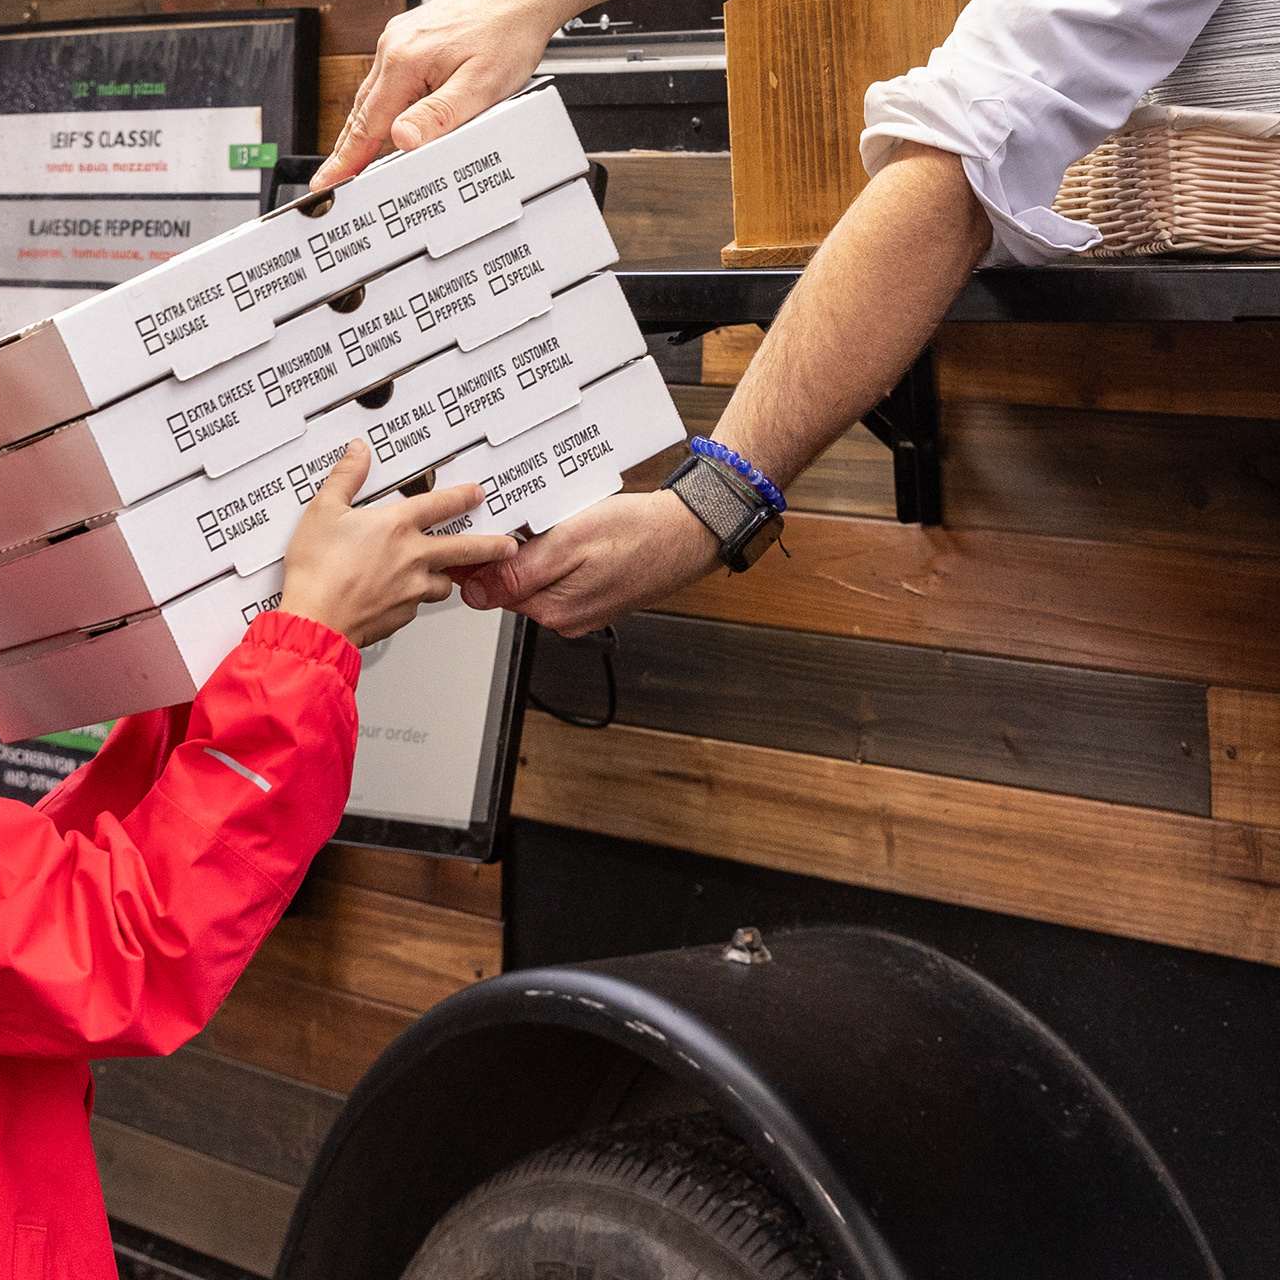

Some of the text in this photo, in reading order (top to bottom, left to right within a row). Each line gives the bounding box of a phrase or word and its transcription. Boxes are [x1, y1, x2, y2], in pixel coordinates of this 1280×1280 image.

[98, 129, 163, 148] CLASSIC
[453, 151, 502, 183] CUSTOMER
[477, 168, 515, 193] SPECIAL
[397, 177, 448, 211] ANCHOVIES
[28, 218, 192, 238] LAKESIDE PEPPERONI
[327, 211, 377, 245] MEAT BALL
[404, 200, 447, 229] PEPPERS
[246, 247, 302, 282] MUSHROOM
[335, 237, 372, 263] ONIONS
[483, 243, 532, 276] CUSTOMER
[254, 268, 308, 302] PEPPERONI
[427, 270, 478, 304] ANCHOVIES
[506, 260, 545, 287] SPECIAL
[156, 283, 225, 326] EXTRA CHEESE
[434, 293, 477, 322] PEPPERS
[163, 315, 210, 345] SAUSAGE
[357, 305, 408, 339] MEAT BALL
[276, 342, 333, 378] MUSHROOM
[365, 330, 402, 357] ONIONS
[511, 336, 560, 370] CUSTOMER
[285, 362, 338, 398] PEPPERONI
[455, 364, 507, 399] ANCHOVIES
[535, 353, 573, 380] SPECIAL
[186, 380, 256, 423] EXTRA CHEESE
[463, 387, 505, 417] PEPPERS
[194, 410, 240, 442] SAUSAGE
[386, 402, 437, 435] MEAT BALL
[395, 426, 432, 453] ONIONS
[553, 424, 601, 457] CUSTOMER
[576, 440, 614, 467] SPECIAL
[306, 442, 349, 475] MUSHRO
[497, 452, 548, 487] ANCHOVIES
[216, 497, 248, 522] EXTRA
[248, 478, 286, 507] CHEESE
[506, 475, 547, 506] PEPPERS
[224, 508, 270, 541] SAUSAGE
[385, 726, 430, 744] order
